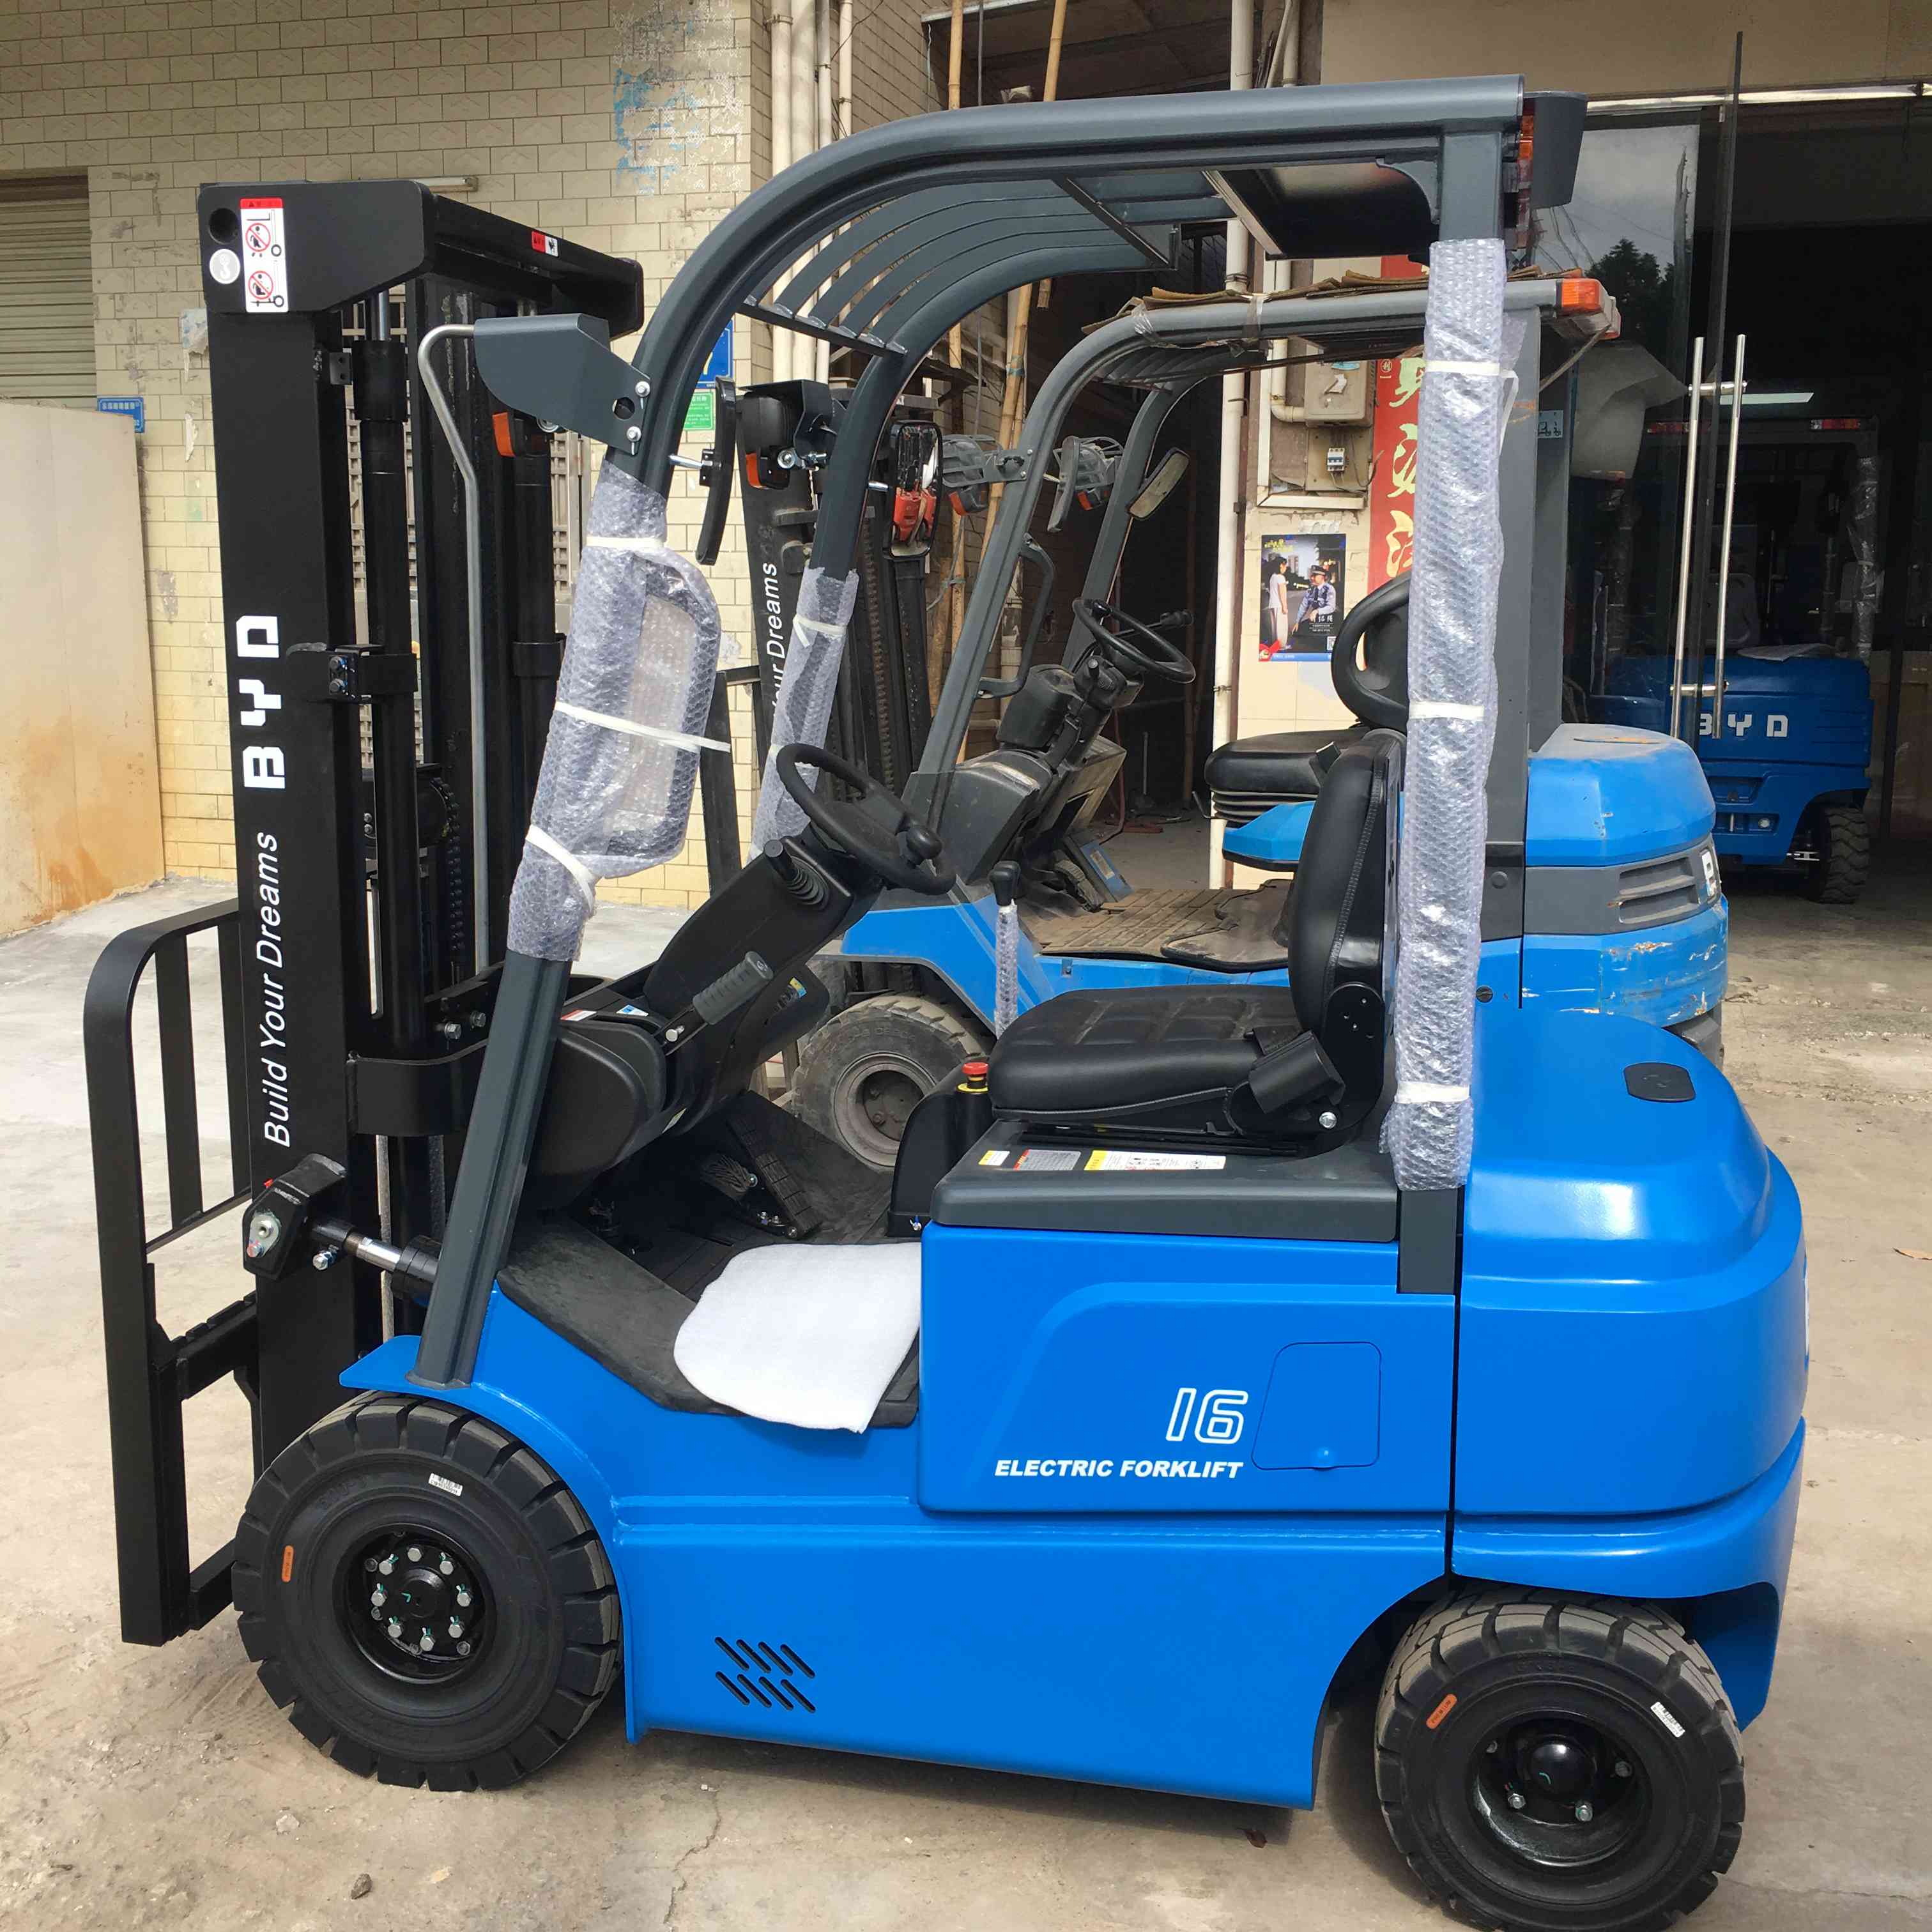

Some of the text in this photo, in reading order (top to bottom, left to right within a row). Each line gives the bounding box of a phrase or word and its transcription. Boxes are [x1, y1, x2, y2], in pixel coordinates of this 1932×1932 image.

[762, 562, 786, 659] Dreams
[234, 615, 286, 790] BYD
[256, 831, 291, 1148] Build Your Dreams
[1165, 1387, 1249, 1445] 16
[994, 1459, 1244, 1478] ELECTRIC FORKLIFT
